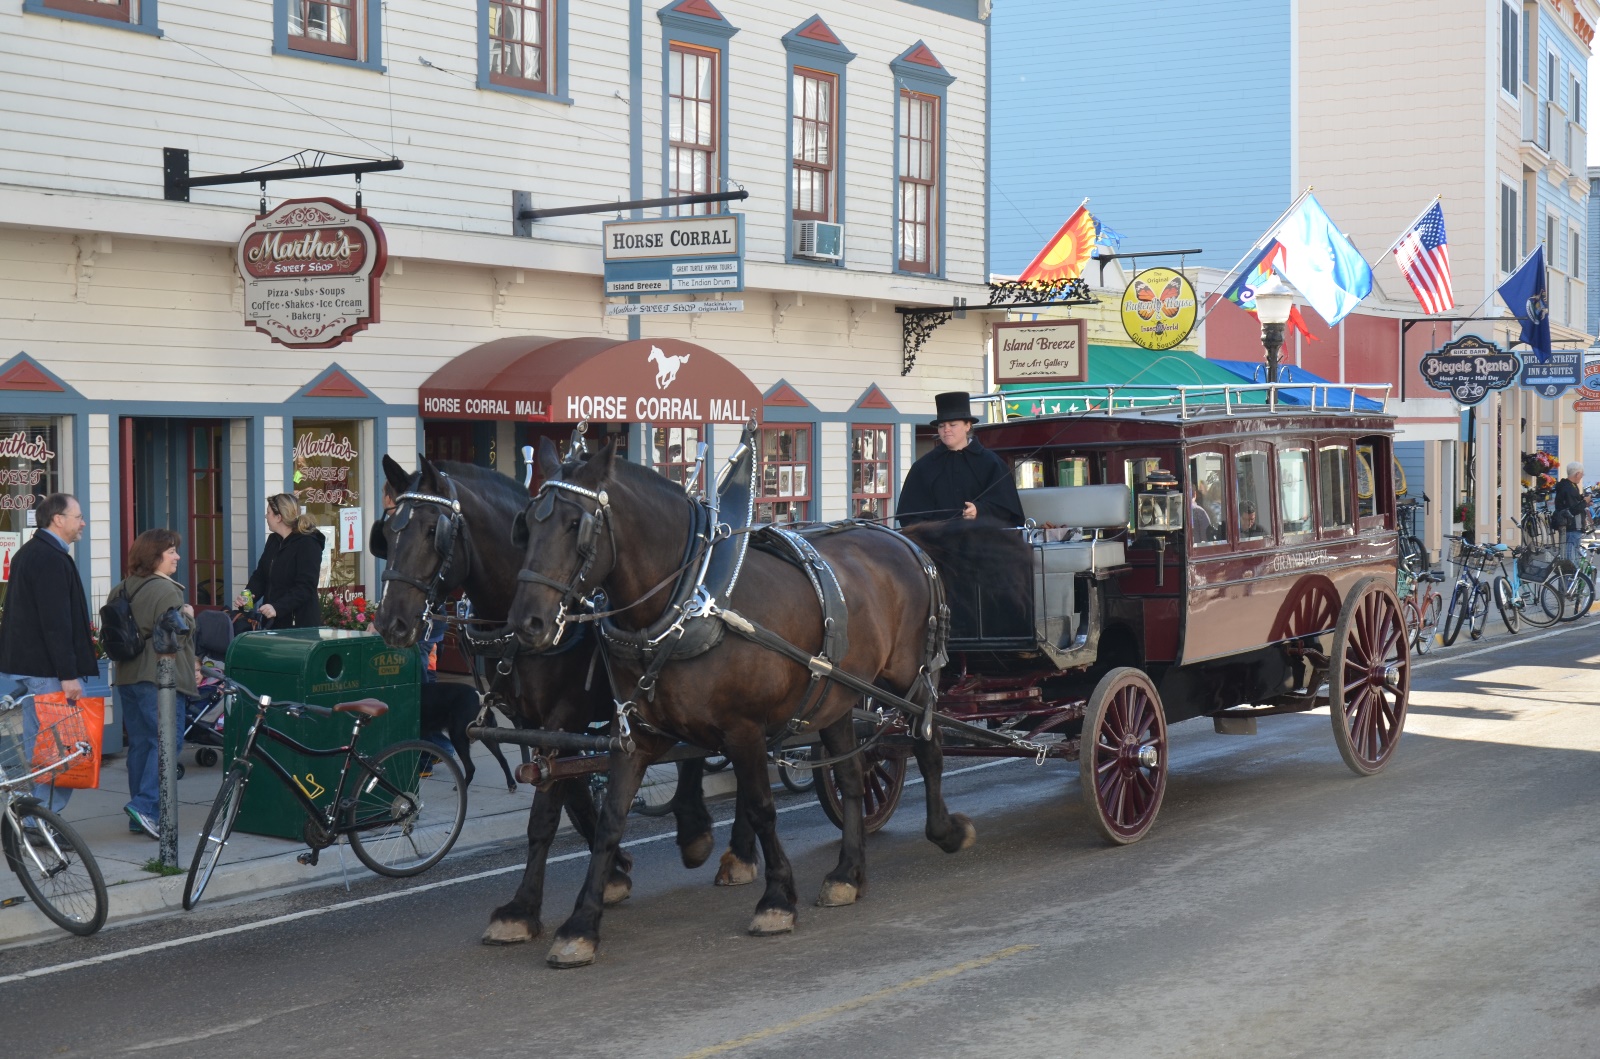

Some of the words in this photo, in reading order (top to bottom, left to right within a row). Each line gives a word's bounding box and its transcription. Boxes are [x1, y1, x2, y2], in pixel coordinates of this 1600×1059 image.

[612, 233, 664, 249] HORSE
[671, 230, 731, 247] CORRAL
[249, 229, 361, 263] Martha's
[637, 282, 662, 290] Breeze
[678, 279, 690, 287] The
[267, 288, 289, 297] Pizza
[294, 287, 314, 296] Subs
[320, 287, 345, 297] Soups
[251, 301, 280, 311] Coffee
[285, 300, 314, 309] Shakes
[320, 299, 333, 308] Ice
[335, 298, 362, 308] Cream
[1164, 296, 1193, 308] House
[292, 311, 320, 322] Bakery
[1003, 338, 1033, 352] Island
[1036, 338, 1076, 350] Breeze
[1132, 332, 1146, 347] Gifts
[1156, 331, 1187, 349] Souvenirs
[1009, 360, 1025, 370] Fine
[1027, 359, 1042, 368] Art
[1044, 358, 1068, 369] Gallery
[1552, 355, 1578, 363] STREET
[1427, 358, 1472, 375] Bicycle
[1474, 358, 1513, 375] Rental
[1550, 367, 1574, 375] SUITES
[424, 397, 460, 413] HORSE
[465, 399, 510, 415] CORRAL
[515, 401, 546, 415] MALL
[567, 395, 627, 419] HORSE
[635, 397, 702, 421] CORRAL
[710, 399, 750, 421] MALL
[293, 432, 358, 461] Martha's
[1274, 553, 1304, 571] GRAND
[1305, 549, 1330, 566] HOTEL
[373, 654, 406, 666] TRASH
[312, 683, 339, 692] BOTTLES
[343, 680, 359, 689] CANS
